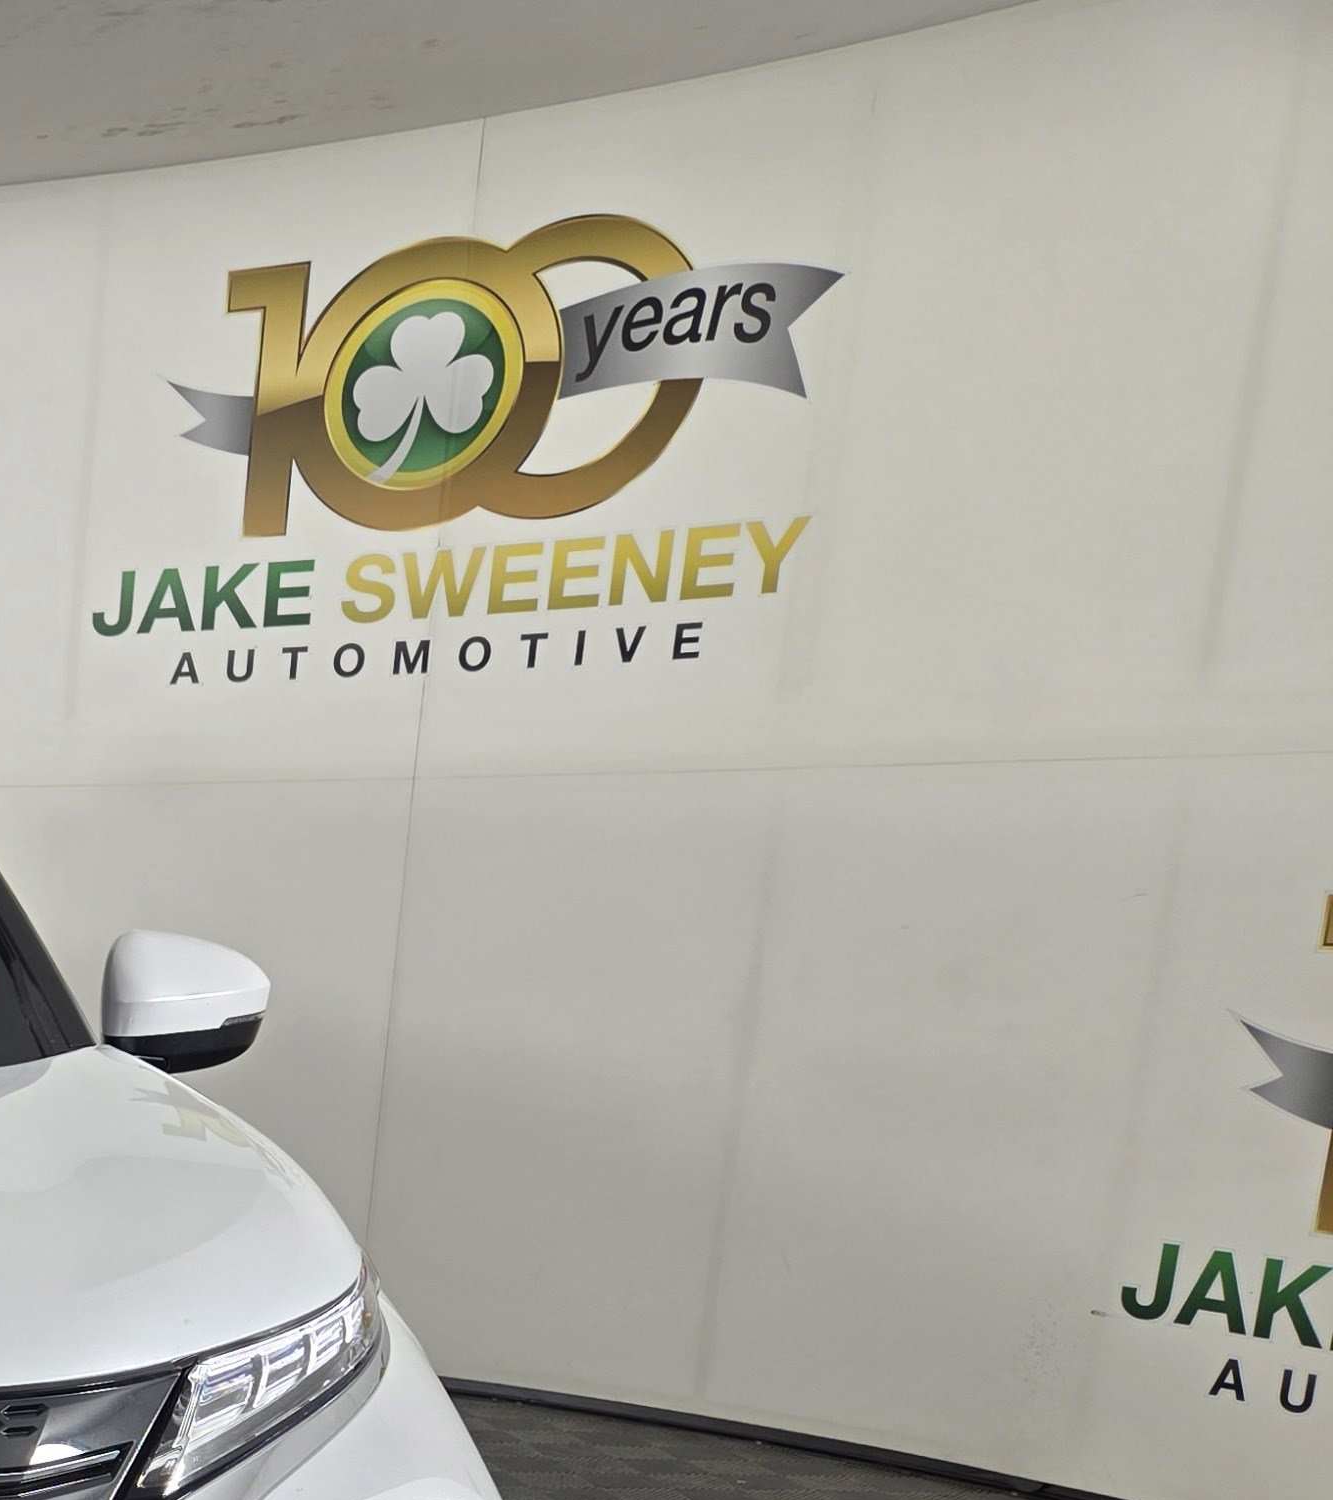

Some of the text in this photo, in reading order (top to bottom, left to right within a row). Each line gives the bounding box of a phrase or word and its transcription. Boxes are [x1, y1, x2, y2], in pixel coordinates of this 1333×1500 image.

[225, 213, 778, 538] 100 years
[91, 515, 813, 638] JAKE SWEENEY
[169, 621, 704, 686] AUTOMOTIVE
[1120, 1242, 1333, 1351] JAK
[1208, 1358, 1318, 1414] AU
